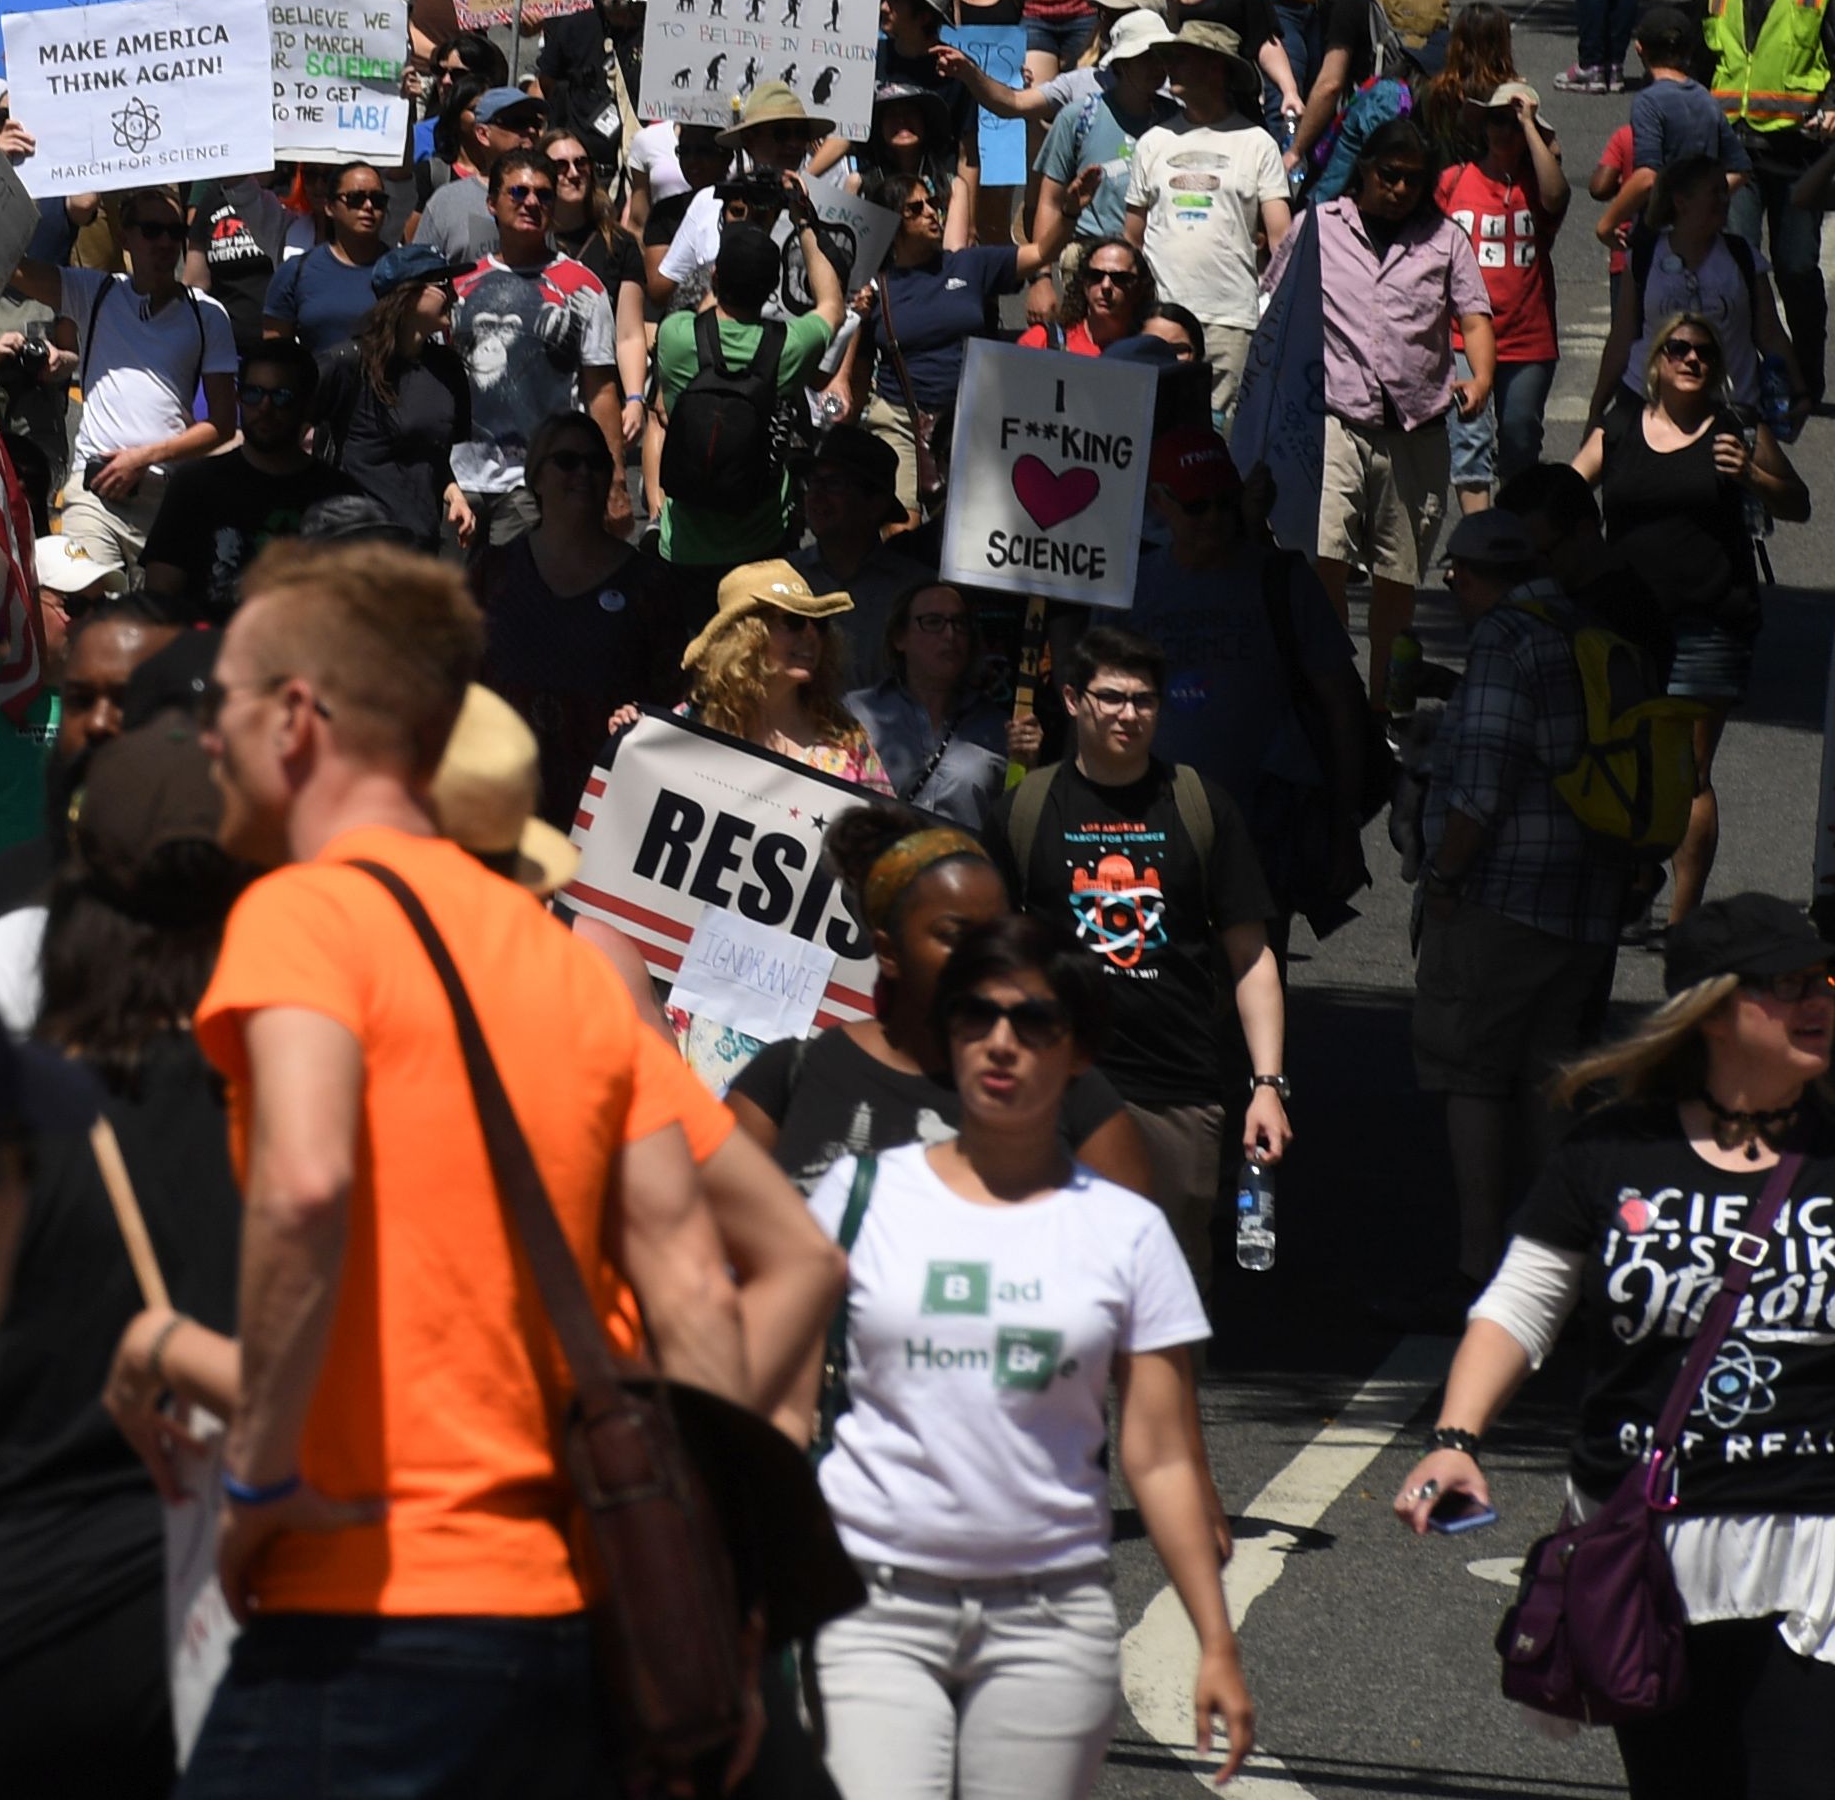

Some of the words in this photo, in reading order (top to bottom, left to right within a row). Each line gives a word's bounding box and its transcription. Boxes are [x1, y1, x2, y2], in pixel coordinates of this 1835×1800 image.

[38, 38, 107, 65] MAKE
[116, 25, 230, 58] AMERICA
[47, 69, 127, 96] THINK
[136, 56, 224, 84] AGAIN!
[51, 160, 112, 181] MARCH
[118, 153, 150, 171] FOR
[158, 144, 230, 165] SCIENCE
[1055, 379, 1065, 413] I
[986, 530, 1106, 581] SCIENCE
[1064, 832, 1100, 842] MARCH
[1101, 833, 1122, 843] FOR
[1124, 832, 1166, 842] SCIENCE
[1081, 823, 1100, 833] LOS
[1102, 823, 1147, 832] ANGELES
[694, 927, 823, 1008] IGNORANCE
